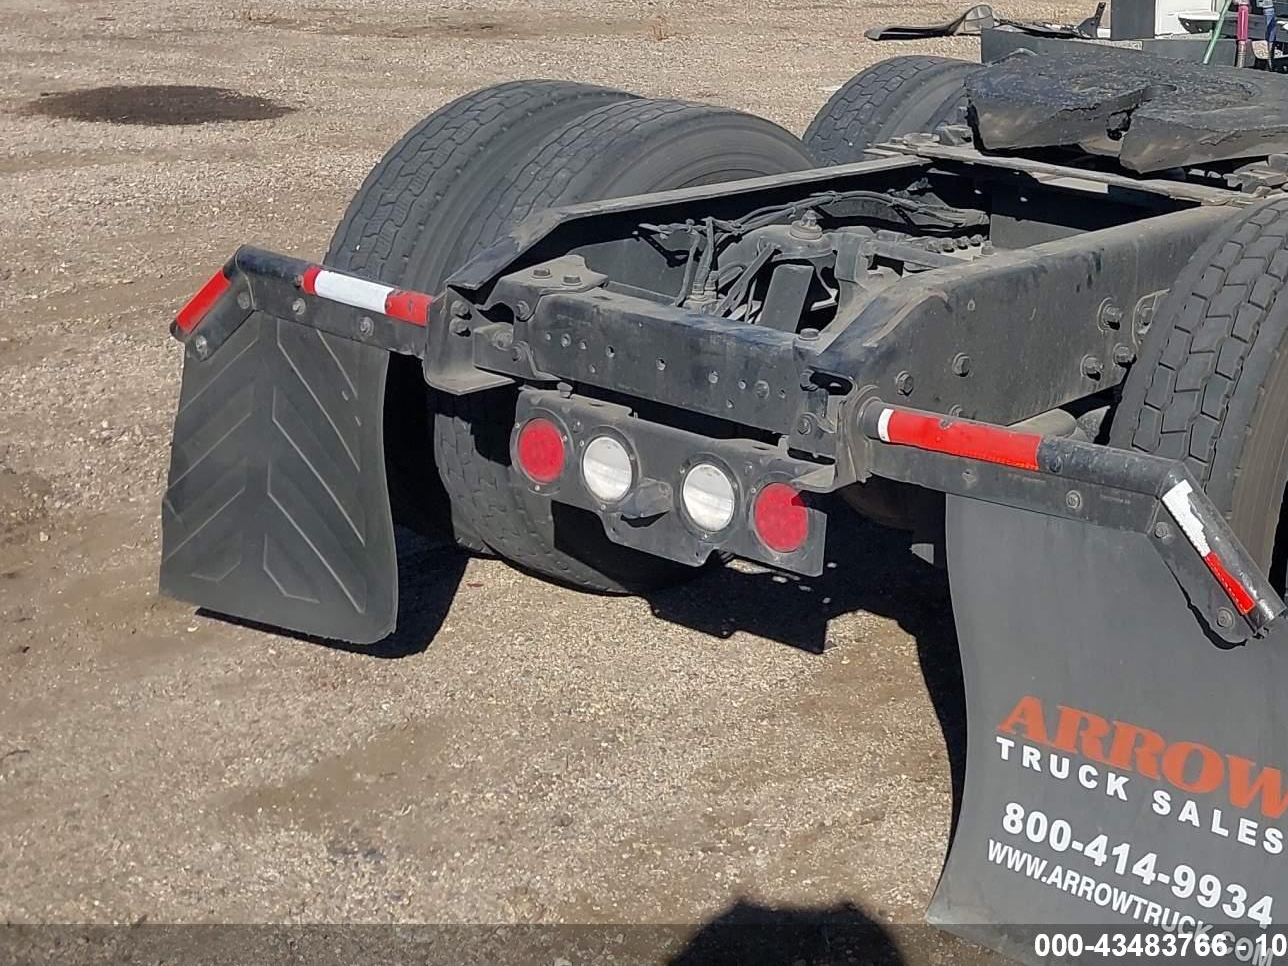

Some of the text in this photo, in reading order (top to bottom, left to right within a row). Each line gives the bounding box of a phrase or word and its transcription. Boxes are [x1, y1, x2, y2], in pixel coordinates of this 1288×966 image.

[996, 736, 1284, 854] TRUCK SALES
[987, 838, 1274, 966] WWW.ARROWTRUCKCOM
[1002, 802, 1273, 929] 800-414-9934
